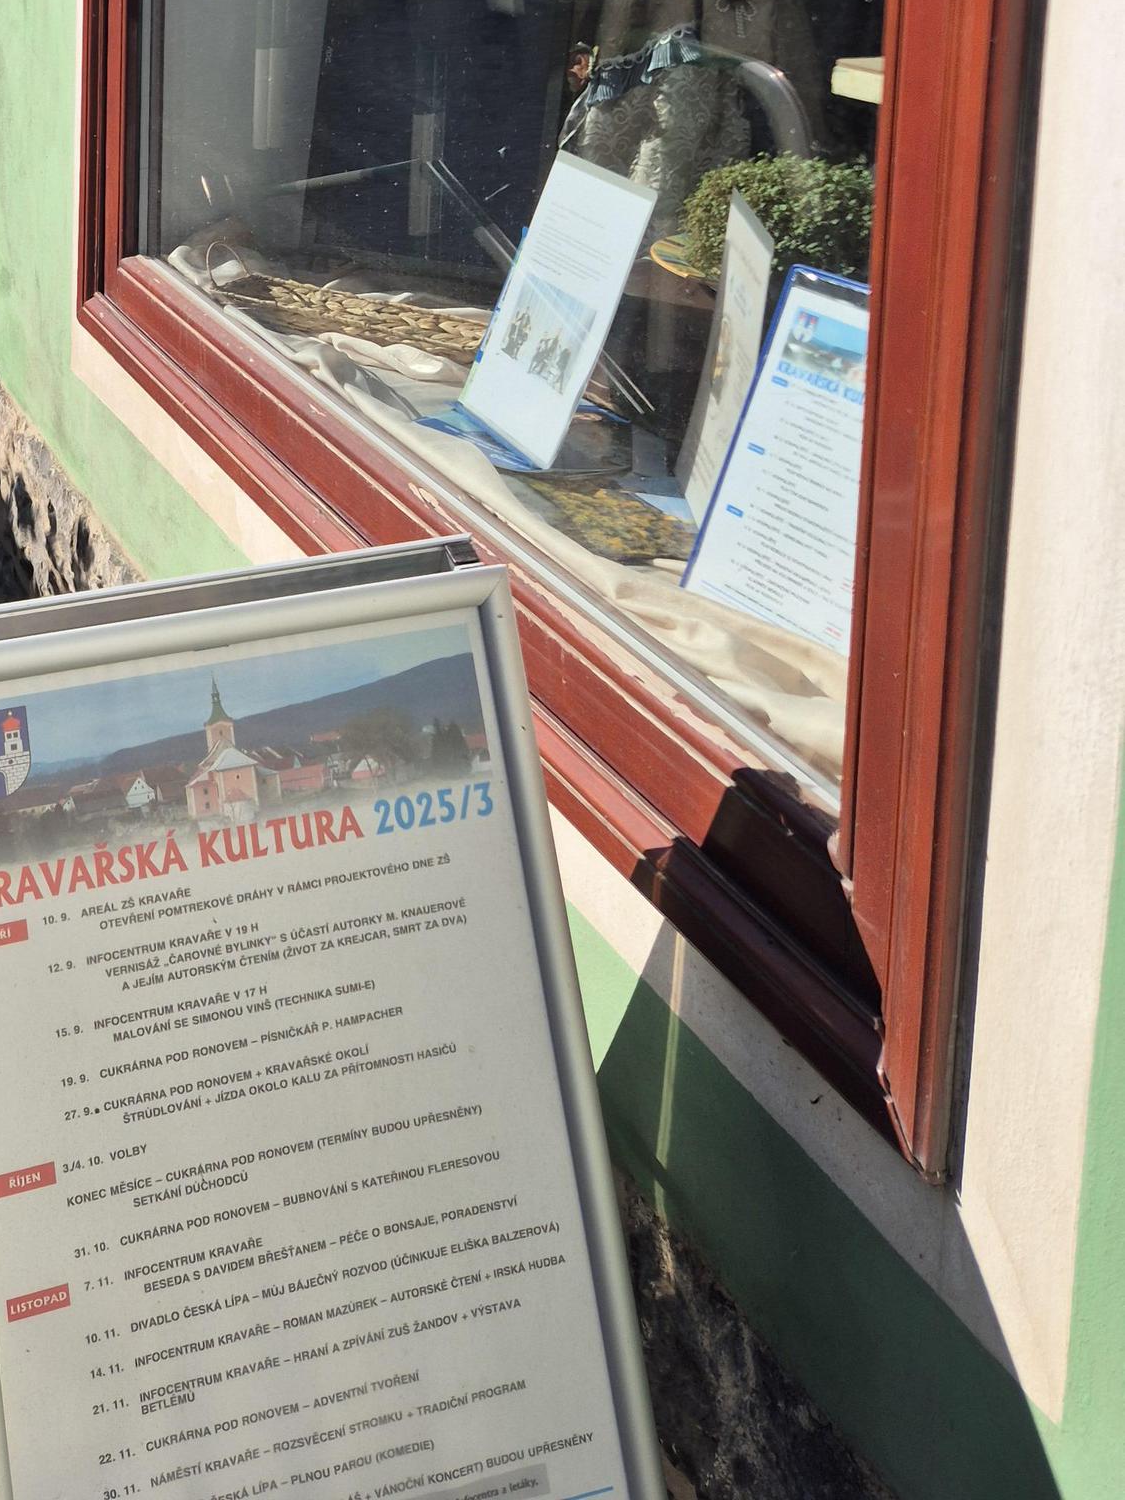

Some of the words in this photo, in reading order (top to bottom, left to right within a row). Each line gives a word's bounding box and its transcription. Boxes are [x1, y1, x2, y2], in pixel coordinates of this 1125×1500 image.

[198, 805, 365, 868] KULTURA
[373, 780, 495, 835] 2025/3
[42, 914, 58, 926] 10.
[59, 912, 71, 923] 9.
[80, 901, 119, 919] AREÁL
[120, 896, 136, 911] ZŠ
[137, 886, 192, 907] KRAVAŘE
[98, 908, 156, 931] OTEVŘENÍ
[157, 893, 235, 919] POMTREKOVÉ
[235, 887, 274, 904] DRÁHY
[276, 884, 285, 896] V
[286, 878, 323, 894] RÁMCI
[323, 861, 410, 887] PROJEKTOVÉHO
[411, 857, 435, 870] DNE
[436, 852, 451, 866] ZŠ
[85, 940, 167, 966] INFOCENTRUM
[168, 928, 223, 949] KRAVAŘE
[224, 927, 233, 938] V
[235, 924, 249, 936] 19
[250, 922, 260, 933] H
[104, 955, 162, 979] VERNISÁŽ
[279, 932, 288, 944] S
[289, 921, 330, 941] ÚČASTÍ
[332, 913, 383, 933] AUTORKY
[385, 911, 399, 923] M.
[400, 896, 466, 920] KNAUEROVÉ
[121, 980, 131, 992] A
[131, 972, 165, 990] JEJÍM
[167, 958, 237, 983] AUTORSKÝM
[238, 949, 281, 968] ČTENÍM
[319, 939, 336, 952] ZA
[336, 928, 391, 948] KREJCAR,
[392, 921, 422, 937] SMRT
[424, 918, 440, 931] ZA
[440, 913, 468, 928] DVA)
[93, 1003, 175, 1031] INFOCENTRUM
[176, 991, 231, 1013] KRAVAŘE
[232, 990, 241, 1001] V
[244, 987, 256, 999] 17
[258, 984, 268, 996] H
[98, 1056, 164, 1079] CUKRÁRNA
[164, 1050, 190, 1065] POD
[191, 1037, 249, 1059] RONOVEM
[259, 1021, 320, 1045] PÍSNIČKÁŘ
[321, 1020, 335, 1032] P.
[334, 1005, 404, 1029] HAMPACHER
[112, 1018, 172, 1043] MALOVÁNÍ
[173, 1016, 190, 1030] SE
[191, 1005, 244, 1026] SIMONOU
[245, 997, 273, 1015] VINŠ
[273, 987, 333, 1011] (TECHNIKA
[334, 979, 376, 996] SUMI-E)
[103, 1088, 168, 1112] CUKRÁRNA
[168, 1082, 194, 1097] POD
[196, 1069, 253, 1091] RONOVEM
[264, 1052, 333, 1076] KRAVAŘSKÉ
[334, 1043, 370, 1061] OKOLÍ
[214, 1087, 247, 1104] JÍZDA
[248, 1078, 289, 1096] OKOLO
[290, 1071, 322, 1088] KALU
[323, 1068, 340, 1081] ZA
[340, 1052, 415, 1077] PŘÍTOMNOSTI
[416, 1043, 457, 1061] HASIČŮ
[8, 1171, 42, 1190] ŘÍJEN
[65, 1187, 107, 1208] KONEC
[109, 1176, 153, 1197] MĚSÍCE
[164, 1159, 230, 1183] CUKRÁRNA
[230, 1152, 256, 1168] POD
[257, 1139, 315, 1162] RONOVEM
[370, 1119, 411, 1137] BUDOU
[87, 1155, 104, 1167] 10.
[108, 1143, 148, 1162] VOLBY
[73, 1246, 91, 1259] 31.
[93, 1241, 110, 1253] 10.
[119, 1221, 185, 1247] CUKRÁRNA
[185, 1215, 211, 1230] POD
[212, 1200, 271, 1224] RONOVEM
[282, 1180, 349, 1208] BUBNOVÁNÍ
[350, 1180, 359, 1192] S
[360, 1166, 425, 1189] KATEŘINOU
[427, 1150, 501, 1175] FLERESOVOU
[132, 1184, 183, 1208] SETKÁNÍ
[123, 1250, 207, 1282] INFOCENTRUM
[208, 1236, 264, 1260] KRAVAŘE
[143, 1272, 191, 1294] BESEDA
[192, 1269, 202, 1282] S
[203, 1256, 256, 1279] DAVIDEM
[257, 1239, 327, 1266] BŘEŠŤANEM
[338, 1228, 370, 1246] PÉČE
[370, 1226, 381, 1239] O
[382, 1214, 440, 1236] BONSAJE,
[440, 1194, 518, 1223] PORADENSTVÍ
[9, 1290, 68, 1316] LISTOPAD
[129, 1310, 181, 1334] DIVADLO
[182, 1298, 223, 1319] ČESKÁ
[223, 1293, 251, 1309] LÍPA
[261, 1283, 286, 1300] MŮJ
[287, 1268, 339, 1294] BÁJEČNÝ
[341, 1259, 389, 1280] ROZVOD
[449, 1236, 490, 1255] ELIŠKA
[134, 1337, 216, 1369] INFOCENTRUM
[217, 1322, 272, 1347] KRAVAŘE
[282, 1310, 324, 1331] ROMAN
[389, 1278, 449, 1304] AUTORSKÉ
[449, 1269, 483, 1289] ČTENÍ
[492, 1261, 527, 1279] IRSKÁ
[527, 1254, 567, 1271] HUDBA
[138, 1371, 224, 1404] INFOCENTRUM
[225, 1355, 281, 1381] KRAVAŘE
[292, 1342, 330, 1364] HRANÍ
[331, 1342, 341, 1354] A
[341, 1327, 386, 1351] ZPÍVÁNÍ
[387, 1322, 411, 1339] ZUŠ
[412, 1312, 459, 1334] ŽANDOV
[470, 1297, 522, 1319] VÝSTAVA
[140, 1391, 196, 1416] BETLÉMŮ
[145, 1425, 213, 1453] CUKRÁRNA
[213, 1418, 239, 1435] POD
[240, 1402, 300, 1427] RONOVEM
[312, 1382, 369, 1409] ADVENTNÍ
[370, 1371, 420, 1392] TVOŘENÍ
[149, 1461, 203, 1489] NÁMĚSTÍ
[204, 1447, 261, 1473] KRAVAŘE
[272, 1423, 347, 1454] ROZSVĚCENÍ
[348, 1410, 404, 1435] STROMKU
[416, 1392, 469, 1417] TRADIČNÍ
[470, 1378, 527, 1403] PROGRAM
[251, 1479, 279, 1496] LÍPA
[289, 1466, 332, 1486] PLNOU
[332, 1454, 373, 1476] PAROU
[375, 1439, 435, 1464] (KOMEDIE)
[373, 1473, 425, 1499] VÁNOČNÍ
[426, 1461, 484, 1485] KONCERT)
[485, 1449, 525, 1469] BUDOU
[527, 1431, 594, 1458] UPŘESNĚNY
